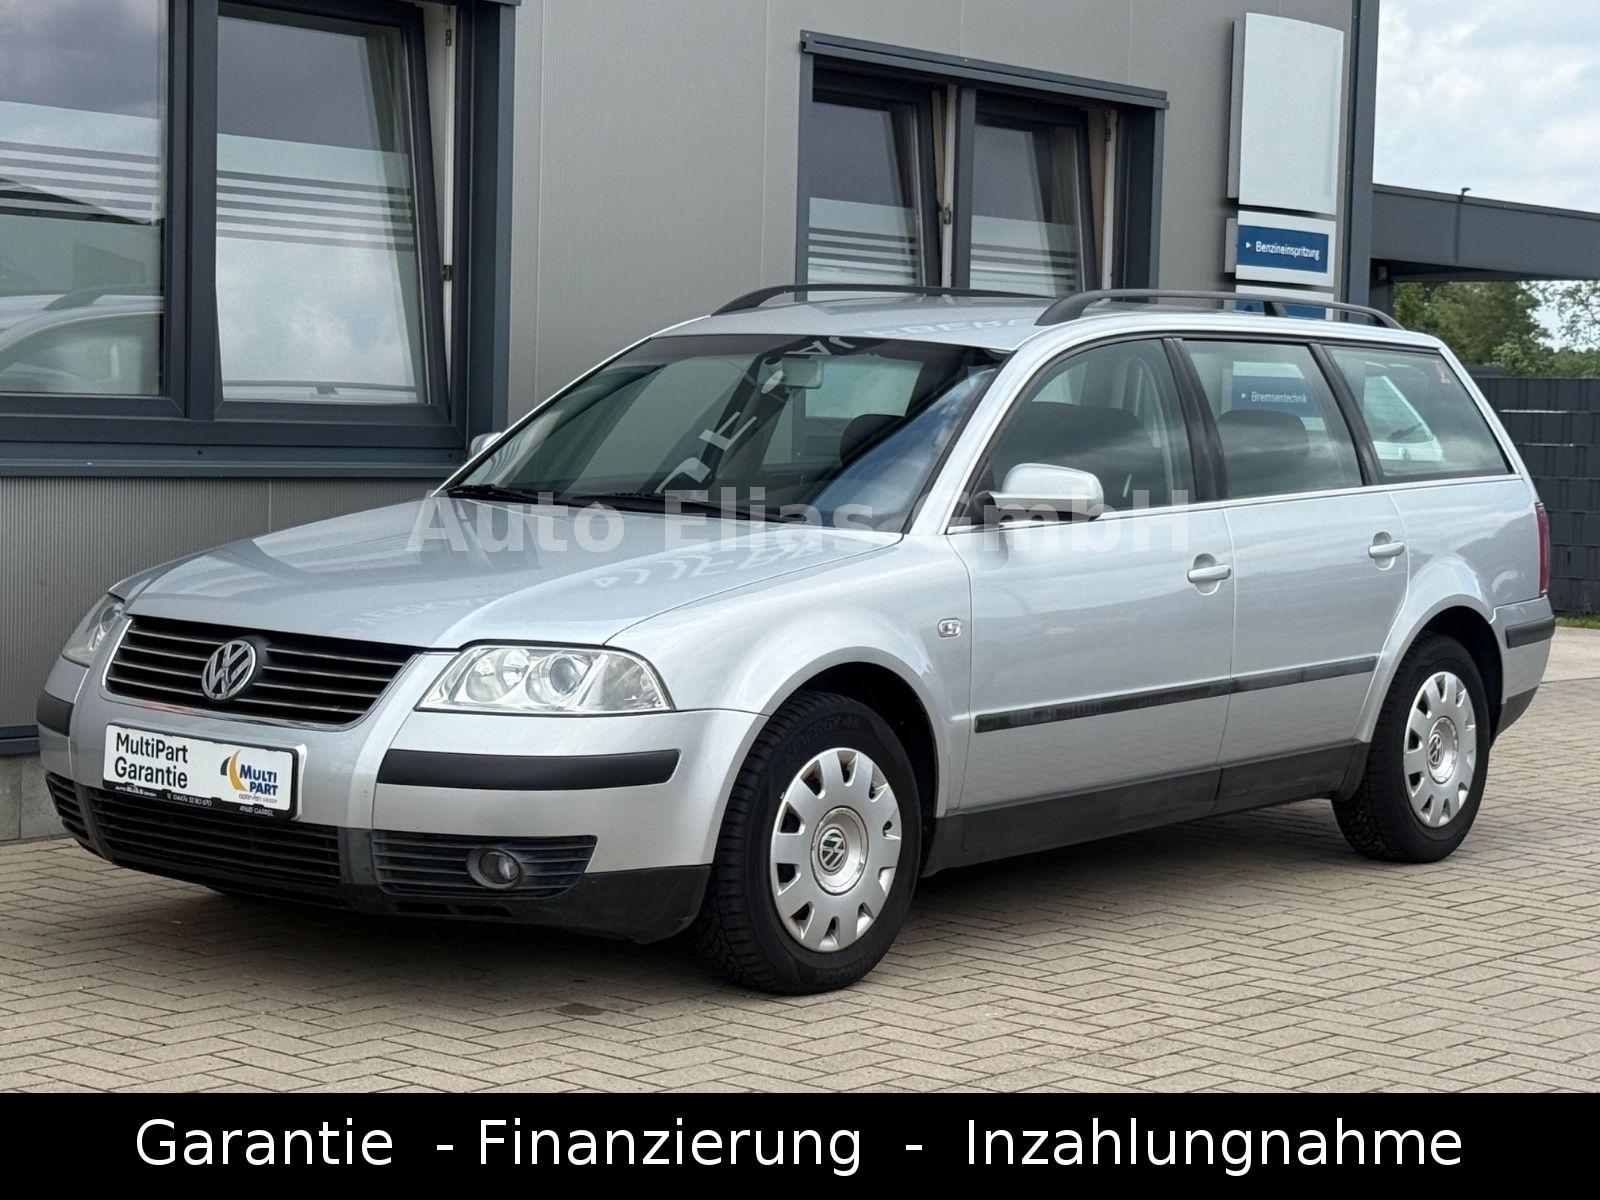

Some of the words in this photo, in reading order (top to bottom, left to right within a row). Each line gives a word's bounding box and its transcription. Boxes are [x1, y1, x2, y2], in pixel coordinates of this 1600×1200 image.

[1255, 240, 1320, 262] Benzineinspritzung
[116, 732, 189, 764] MultiPart
[114, 756, 188, 789] Garantie
[239, 764, 278, 785] MULTI
[249, 782, 279, 796] PART
